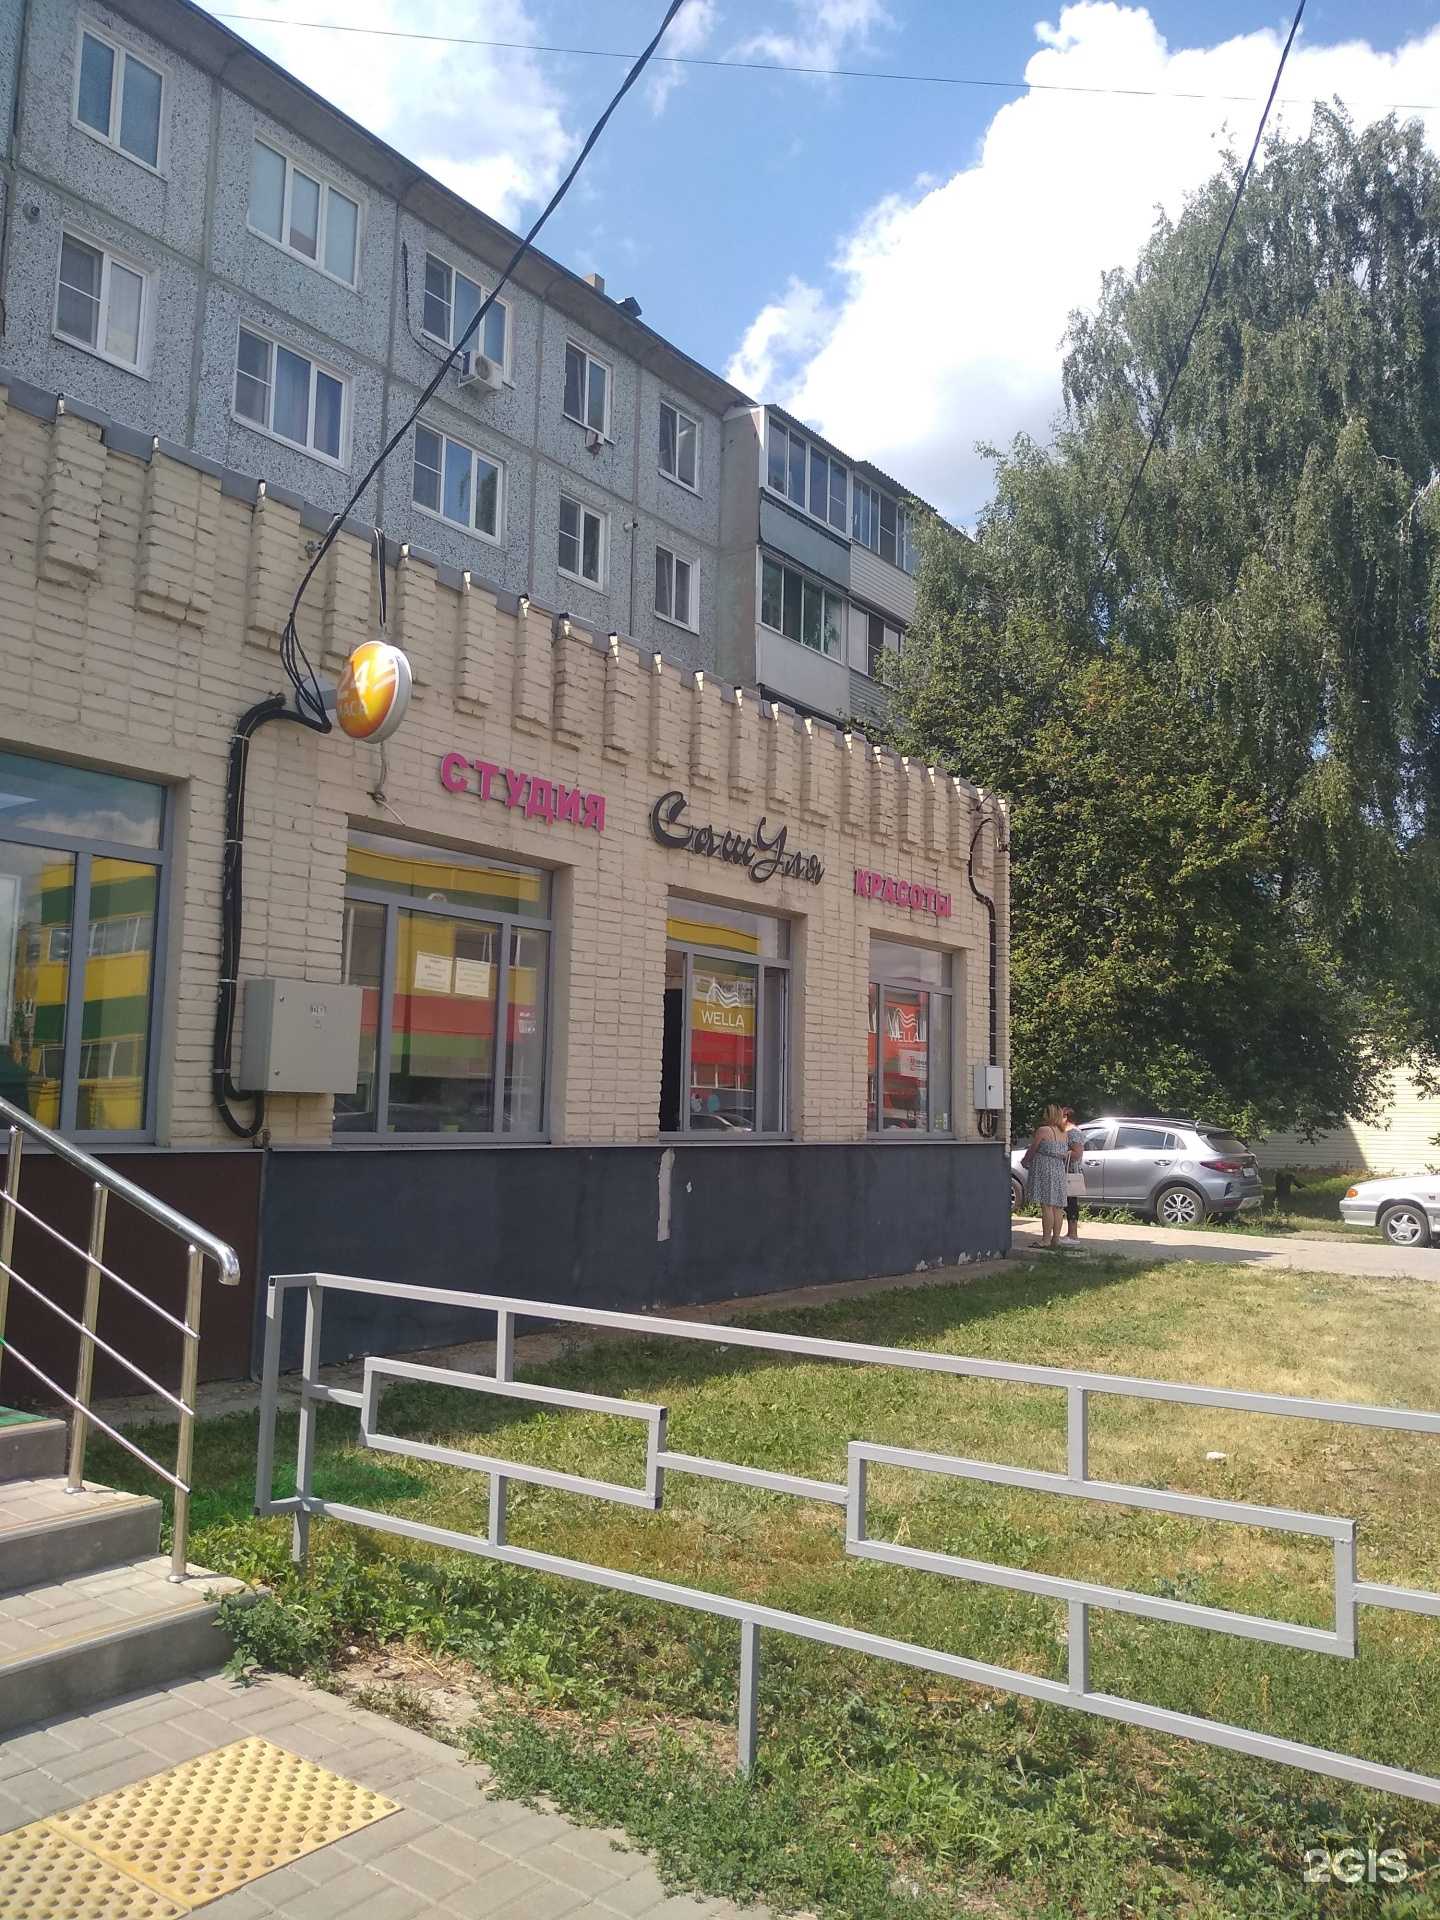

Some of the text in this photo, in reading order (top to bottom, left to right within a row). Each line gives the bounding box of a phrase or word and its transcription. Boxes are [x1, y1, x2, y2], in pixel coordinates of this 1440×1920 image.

[439, 752, 606, 832] СТУДИЯ
[854, 868, 952, 918] КРАСОТЫ
[701, 1009, 745, 1028] WELLA
